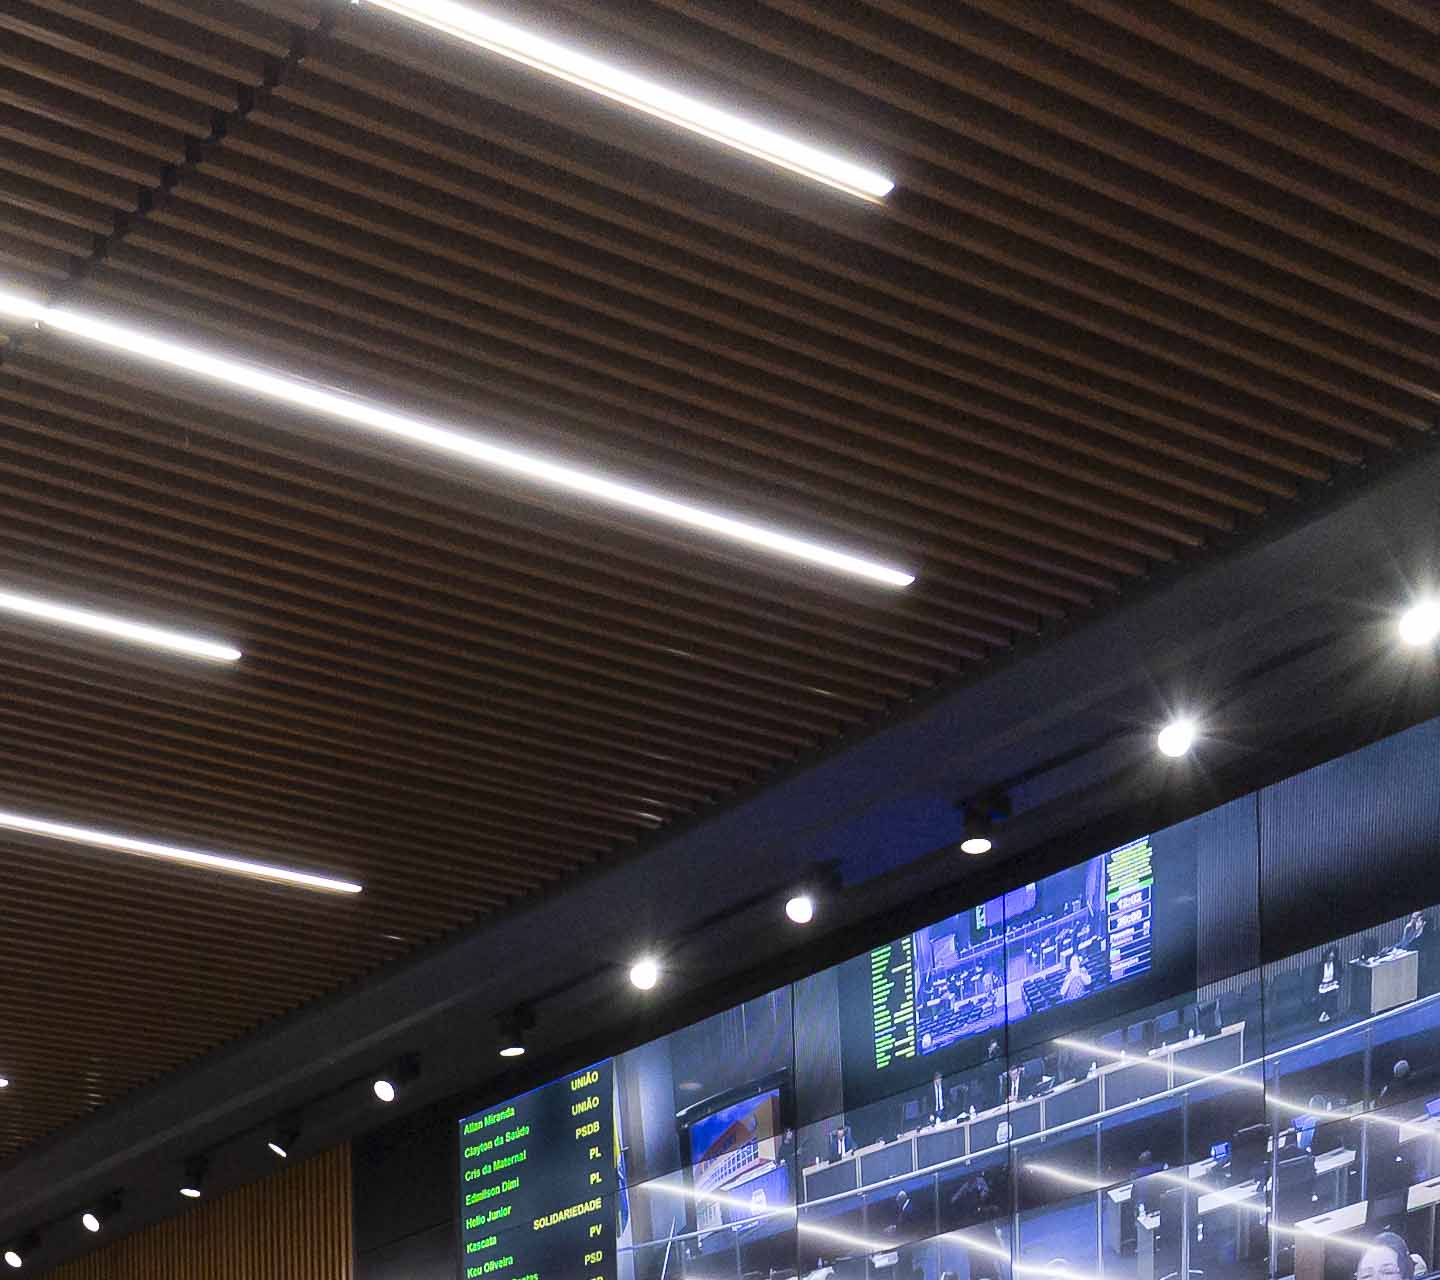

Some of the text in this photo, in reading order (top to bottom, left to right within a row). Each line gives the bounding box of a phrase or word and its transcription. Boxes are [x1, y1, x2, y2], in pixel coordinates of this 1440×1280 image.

[571, 1071, 599, 1091] UNIÃO
[572, 1097, 600, 1116] UNIÃO
[576, 1121, 600, 1139] PSDB
[590, 1146, 602, 1160] PL
[590, 1172, 602, 1185] PL
[533, 1197, 602, 1230] SOLIDARIEDADE
[590, 1224, 602, 1237] PV
[584, 1251, 603, 1265] PSD
